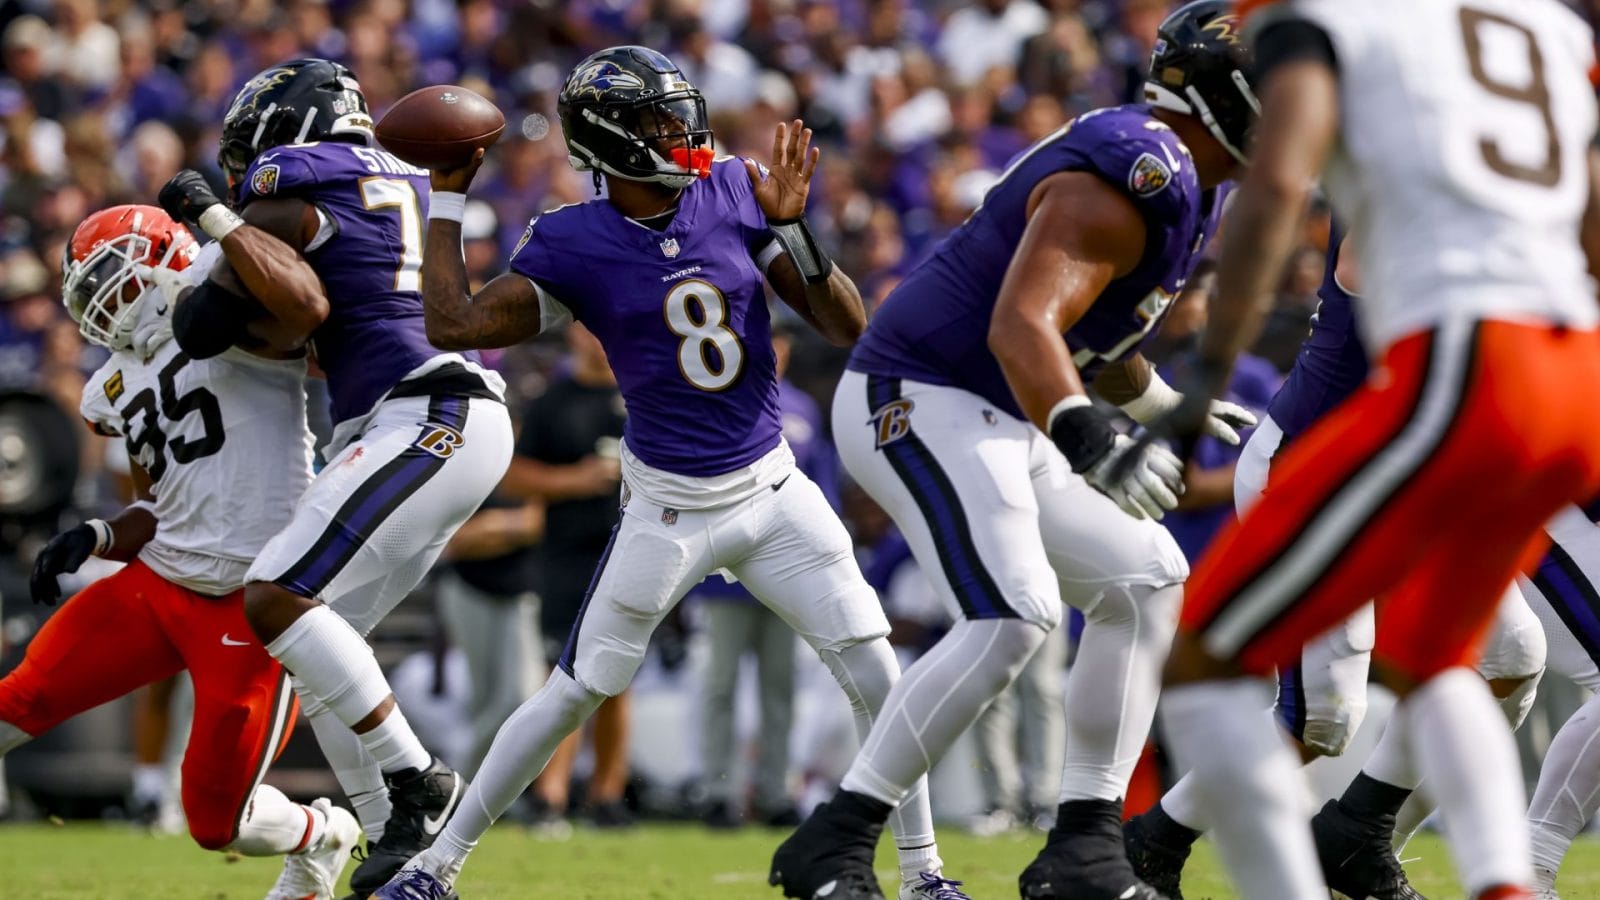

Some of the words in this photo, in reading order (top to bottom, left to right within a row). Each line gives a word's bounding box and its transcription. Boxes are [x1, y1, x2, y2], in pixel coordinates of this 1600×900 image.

[1457, 6, 1562, 190] 9
[661, 265, 702, 283] RAVENS
[663, 278, 743, 391] 8
[121, 351, 226, 483] 95
[412, 421, 466, 459] B
[866, 397, 915, 450] B
